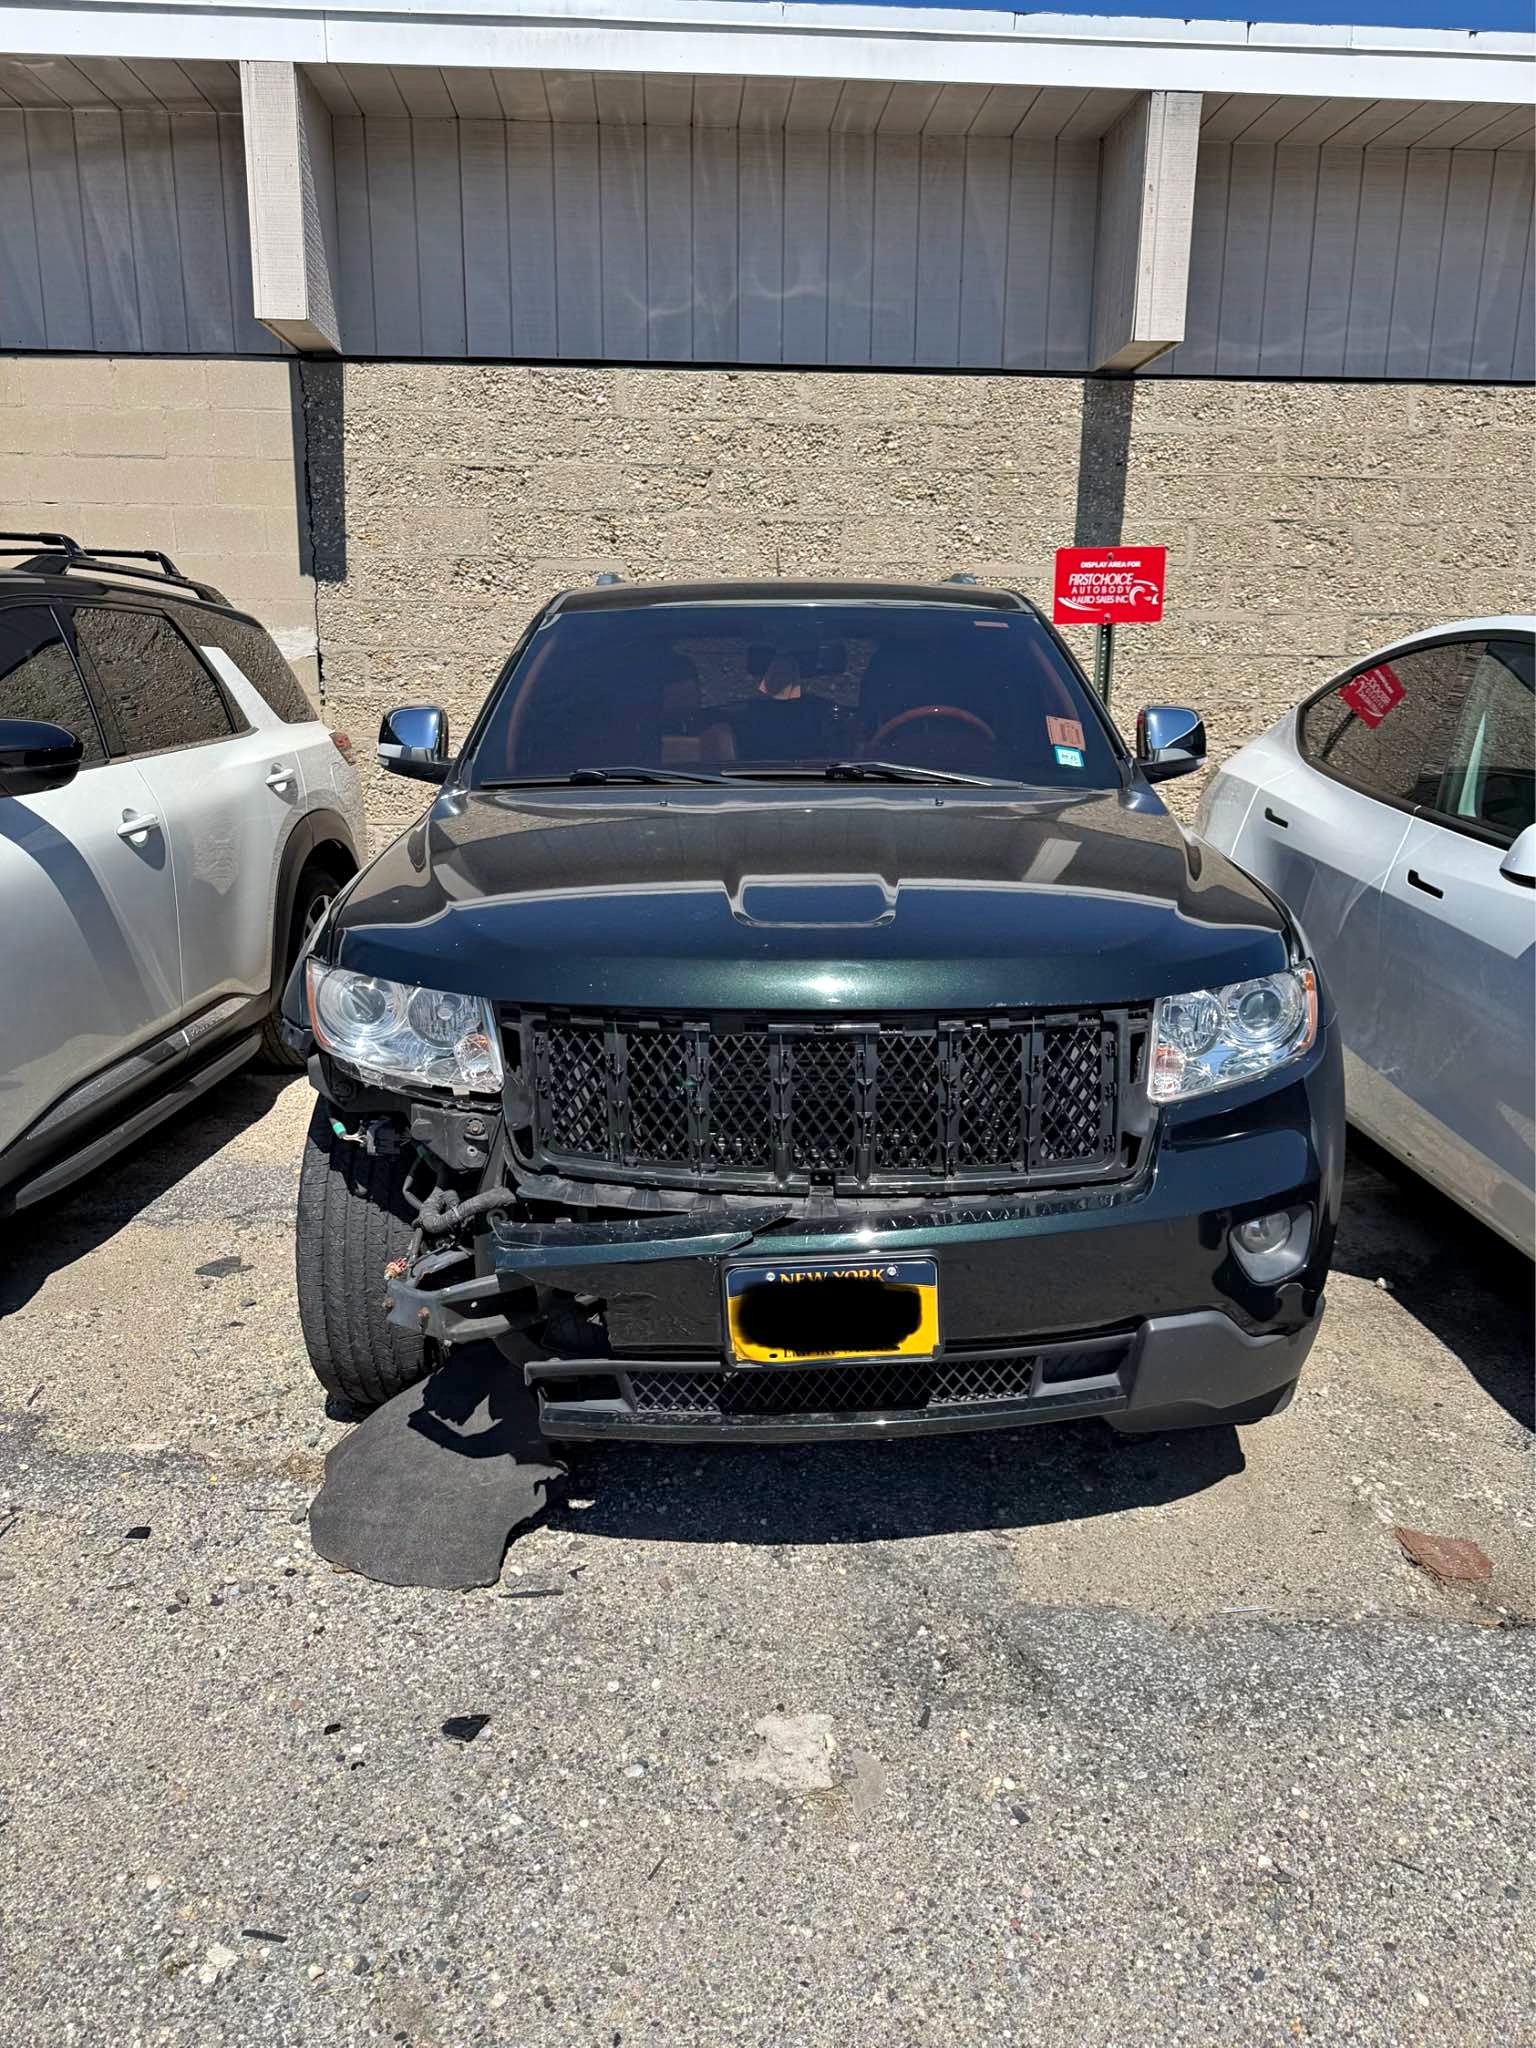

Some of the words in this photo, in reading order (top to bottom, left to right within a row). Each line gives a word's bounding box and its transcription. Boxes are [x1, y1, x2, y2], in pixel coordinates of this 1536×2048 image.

[1071, 585, 1131, 594] AUTOBODY
[1095, 595, 1114, 604] SALES
[1115, 595, 1129, 604] INC
[780, 1271, 828, 1284] NEW
